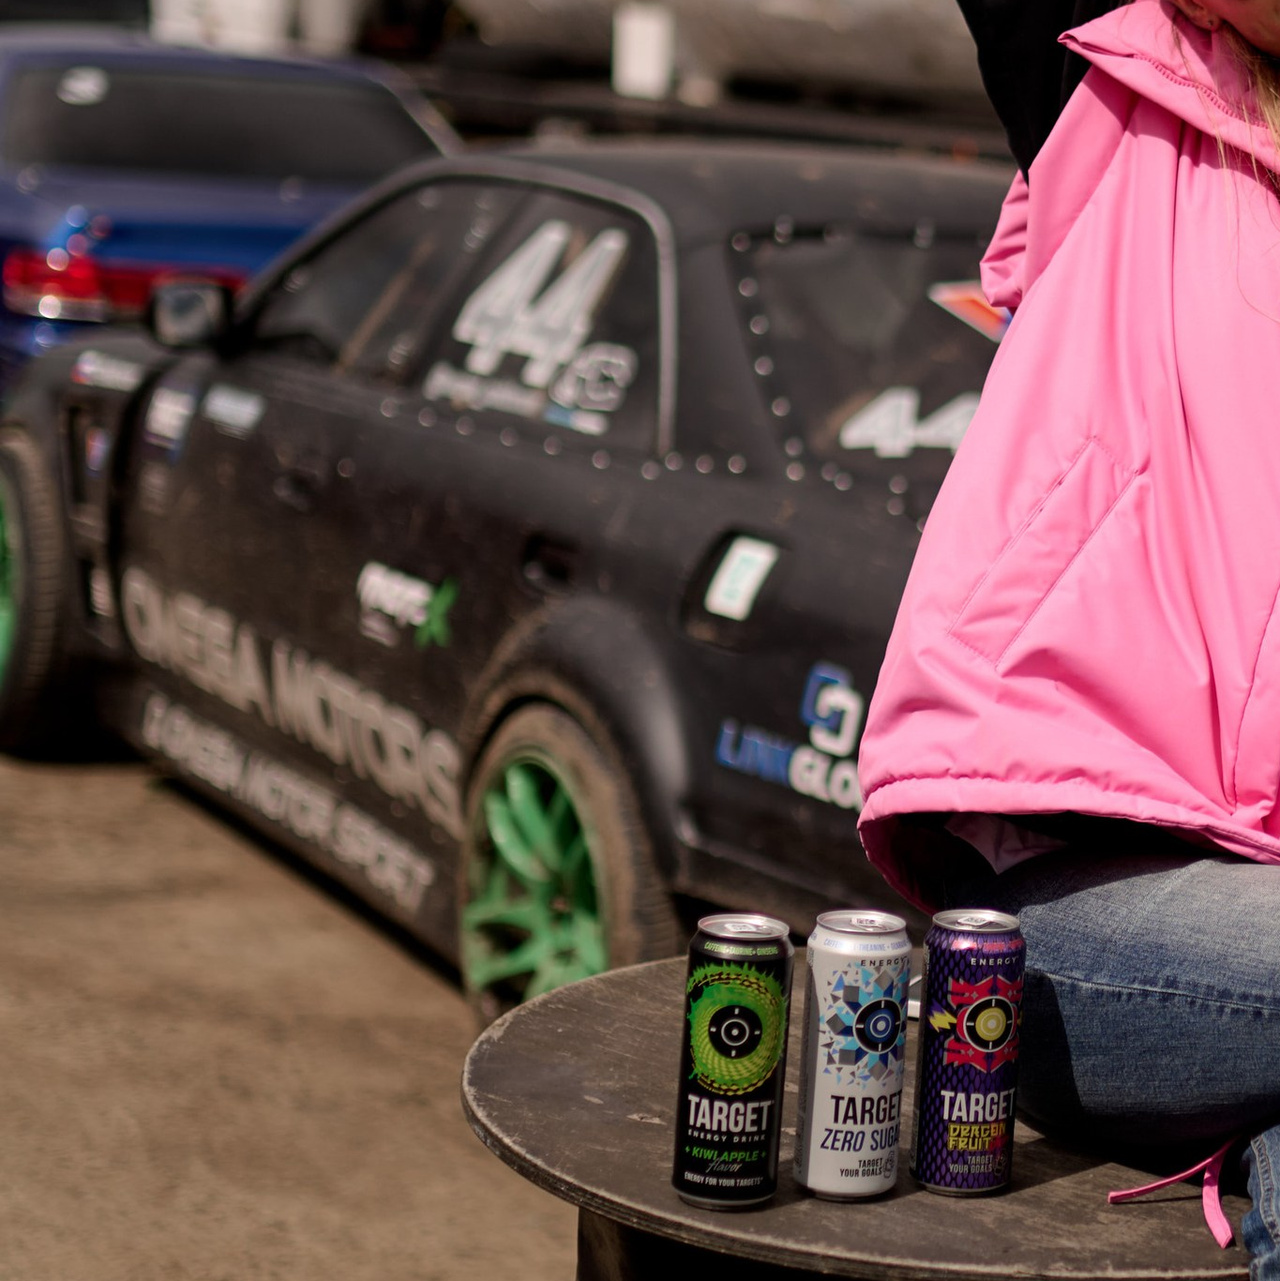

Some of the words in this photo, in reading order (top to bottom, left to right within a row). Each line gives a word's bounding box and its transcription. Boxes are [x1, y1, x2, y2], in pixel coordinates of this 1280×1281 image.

[861, 956, 908, 967] ENERGY
[971, 956, 1016, 966] ENERGY
[831, 1089, 902, 1125] TARGET
[941, 1088, 1016, 1122] TARGET
[688, 1094, 772, 1133] TARGET
[688, 1129, 727, 1142] ENERGY
[733, 1135, 765, 1143] DRINK
[948, 1122, 1006, 1137] DRAGON
[820, 1128, 866, 1152] ZERO
[948, 1137, 991, 1151] FRUIT
[692, 1146, 718, 1160] KIWI
[720, 1150, 760, 1162] APPLE
[967, 1155, 993, 1165] TARGET
[706, 1157, 743, 1173] flavor
[858, 1157, 883, 1169] TARGET
[949, 1164, 969, 1173] YOUR
[970, 1164, 993, 1173] GOALS
[684, 1171, 704, 1184] ENERGY
[705, 1177, 717, 1186] FOR
[718, 1178, 735, 1187] YOUR
[736, 1177, 762, 1187] TARGETS
[840, 1168, 859, 1177] YOUR
[861, 1167, 883, 1177] GOALS
